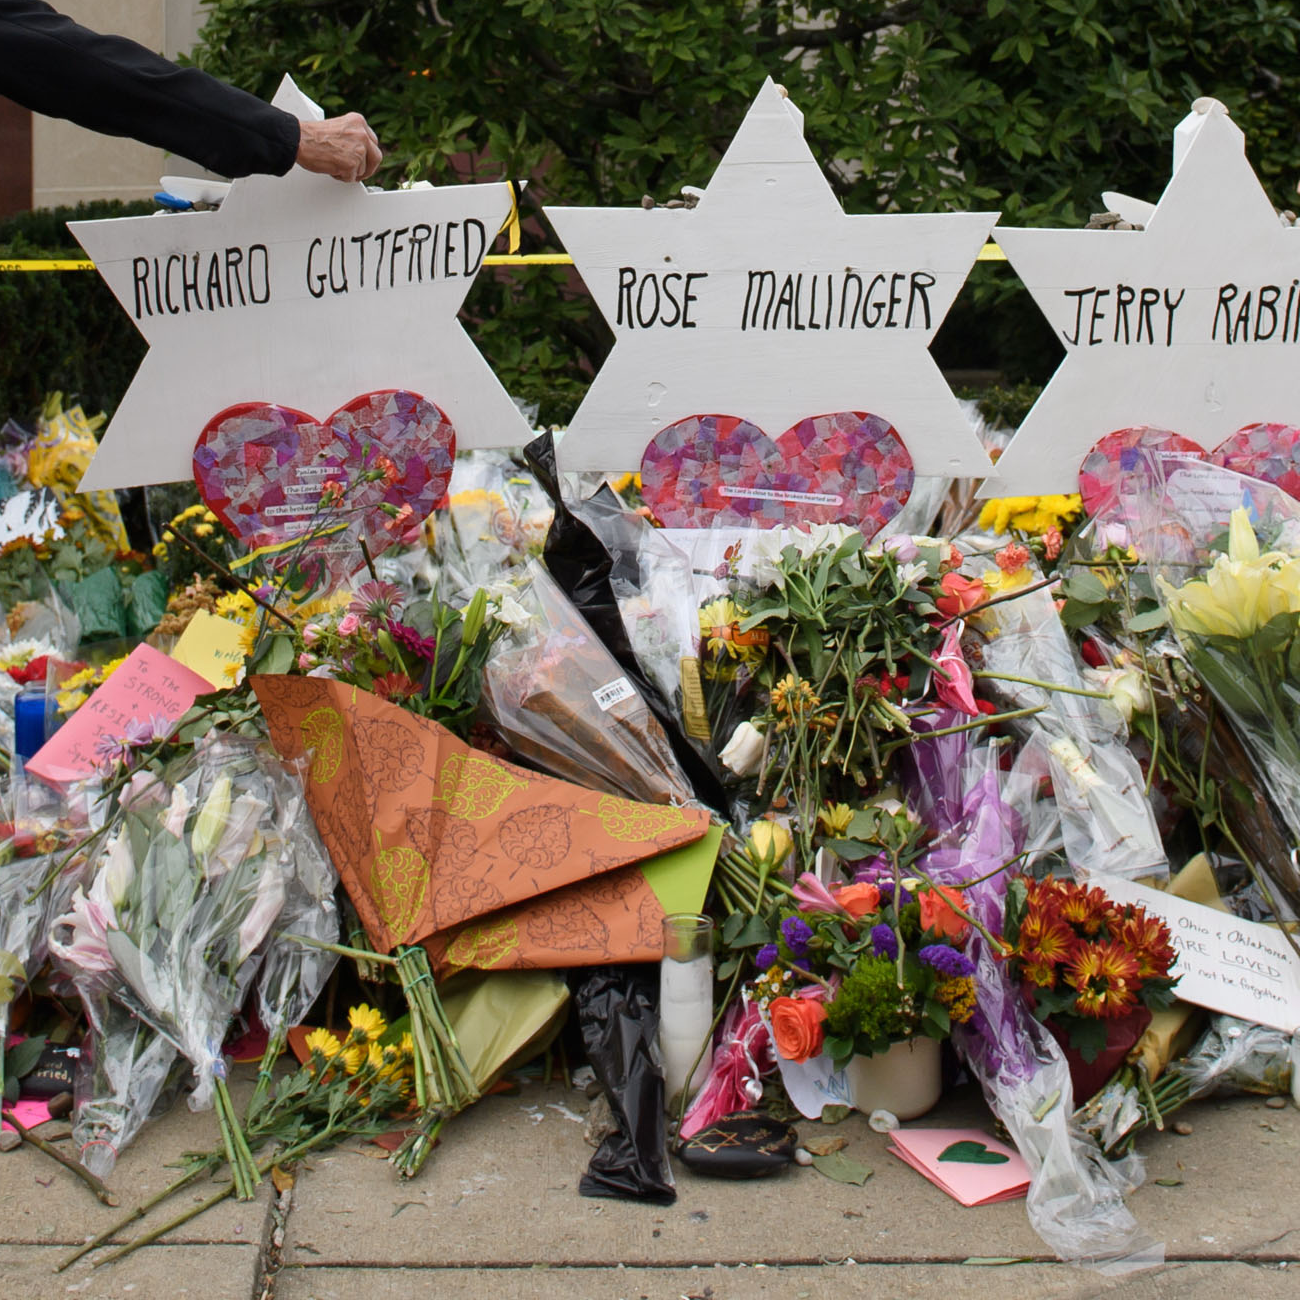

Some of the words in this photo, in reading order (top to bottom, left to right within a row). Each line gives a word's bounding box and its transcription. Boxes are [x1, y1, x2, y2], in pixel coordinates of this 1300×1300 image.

[133, 244, 271, 320] RICHARD
[616, 267, 709, 329] ROSE
[741, 270, 936, 331] MALLINGER
[1063, 285, 1185, 346] JERRY
[124, 676, 182, 714] STRONG
[1177, 916, 1209, 936] Ohio
[1172, 935, 1211, 957] ARE
[1174, 960, 1192, 972] ill
[1198, 968, 1217, 981] not
[1222, 950, 1281, 979] LOVED
